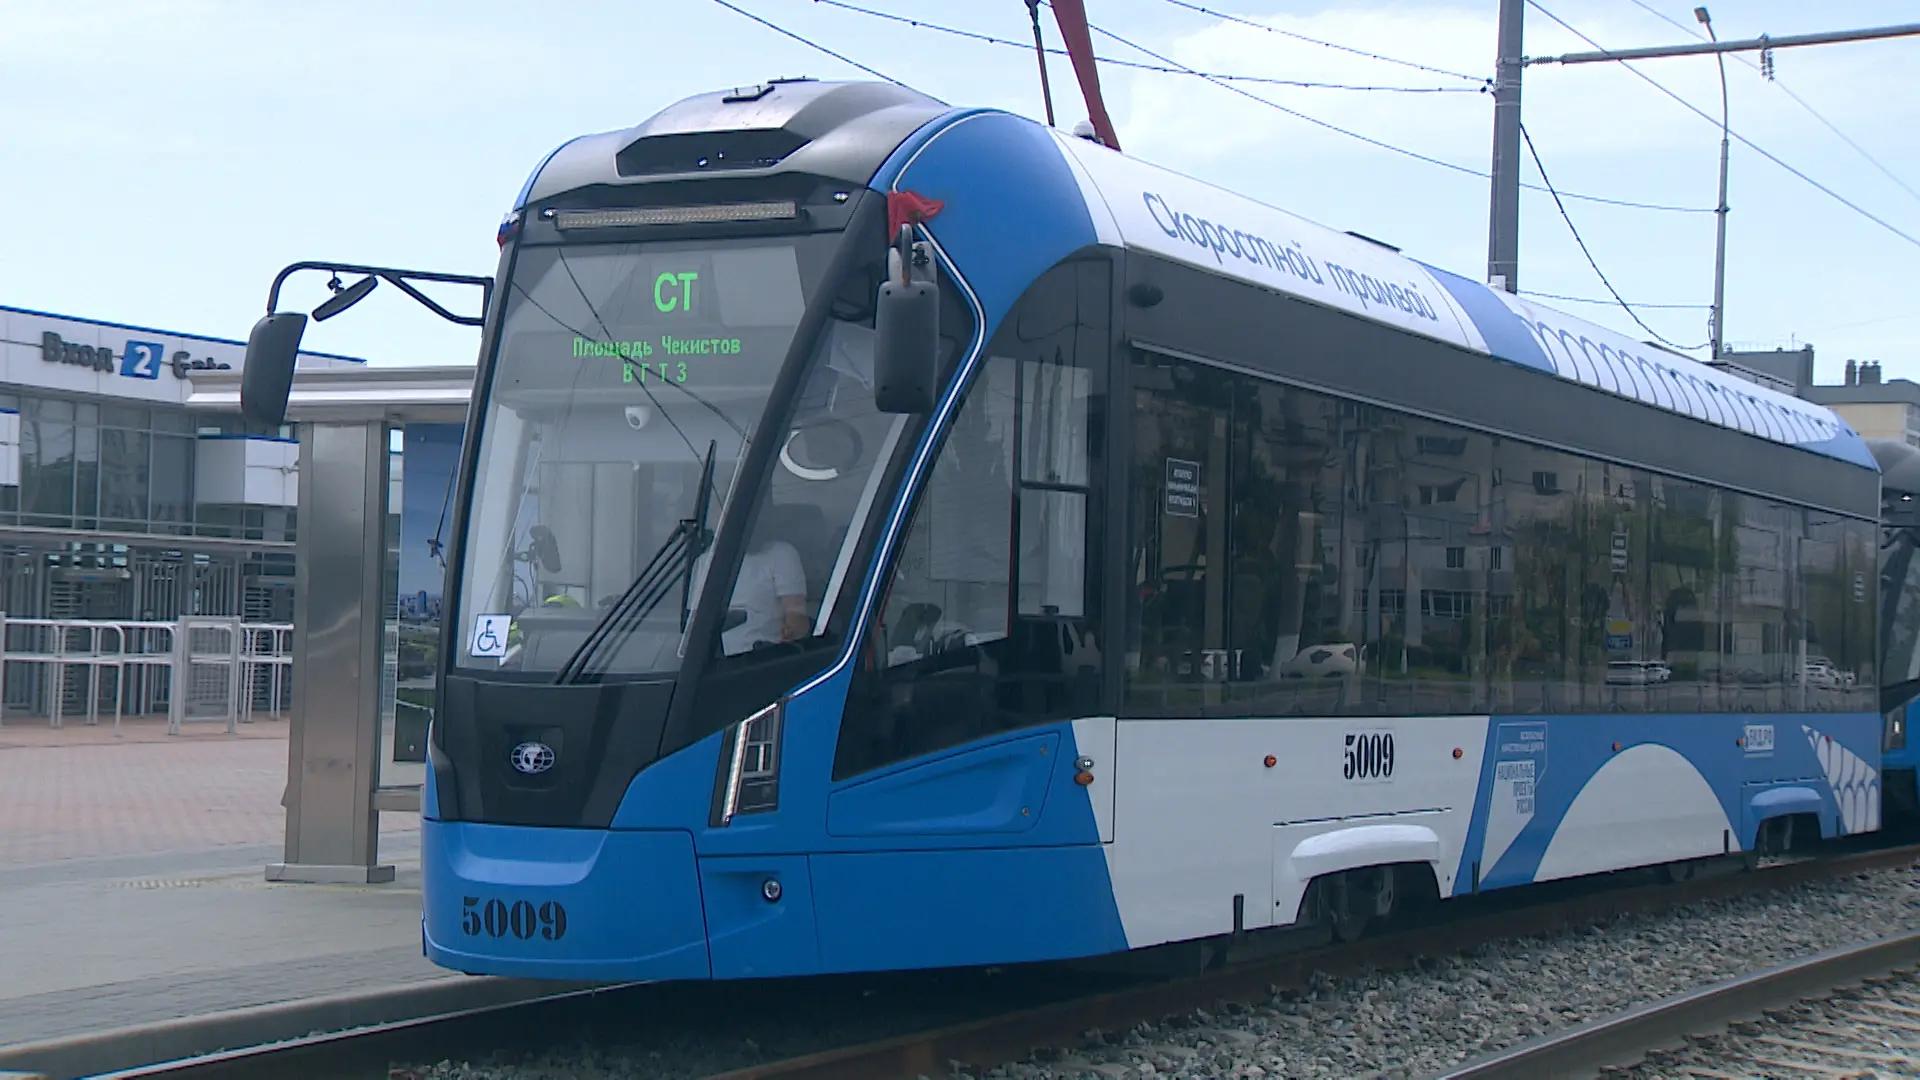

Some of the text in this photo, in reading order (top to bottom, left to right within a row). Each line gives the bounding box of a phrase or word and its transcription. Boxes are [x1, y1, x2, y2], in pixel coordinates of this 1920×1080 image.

[1142, 190, 1440, 322] Скоростной трамвай
[654, 271, 698, 313] СТ
[41, 331, 115, 374] Вход
[132, 345, 153, 375] 2
[573, 335, 741, 360] Площадь Чекистов
[1344, 732, 1394, 780] 5009
[462, 895, 567, 941] 5009
